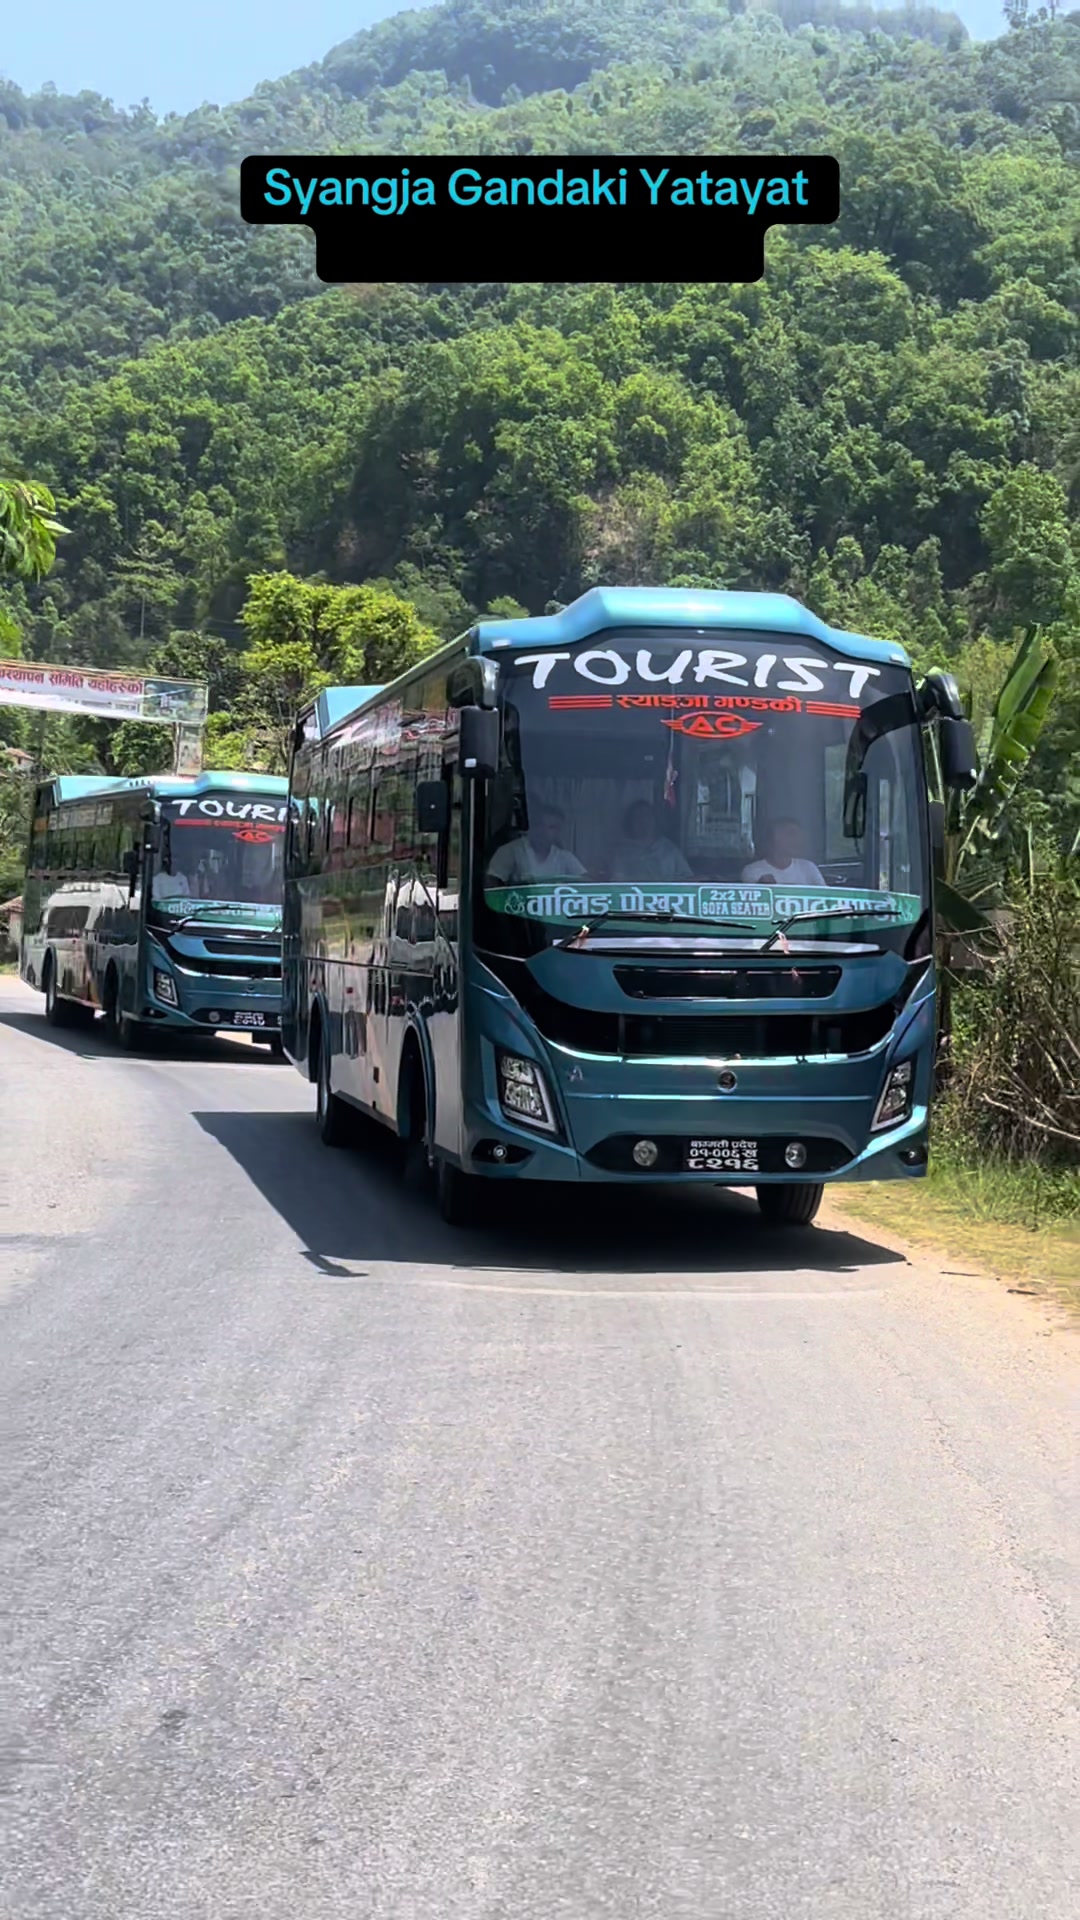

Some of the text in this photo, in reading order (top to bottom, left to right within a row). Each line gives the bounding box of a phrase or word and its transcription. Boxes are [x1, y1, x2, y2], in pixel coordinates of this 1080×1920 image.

[514, 649, 881, 698] TOURIST
[714, 695, 802, 713] गण्डकी
[687, 716, 738, 733] AC
[526, 886, 612, 917] वालिङ
[620, 887, 696, 915] पोखरा
[739, 890, 762, 901] VIP
[702, 902, 770, 916] SOFA SEATER
